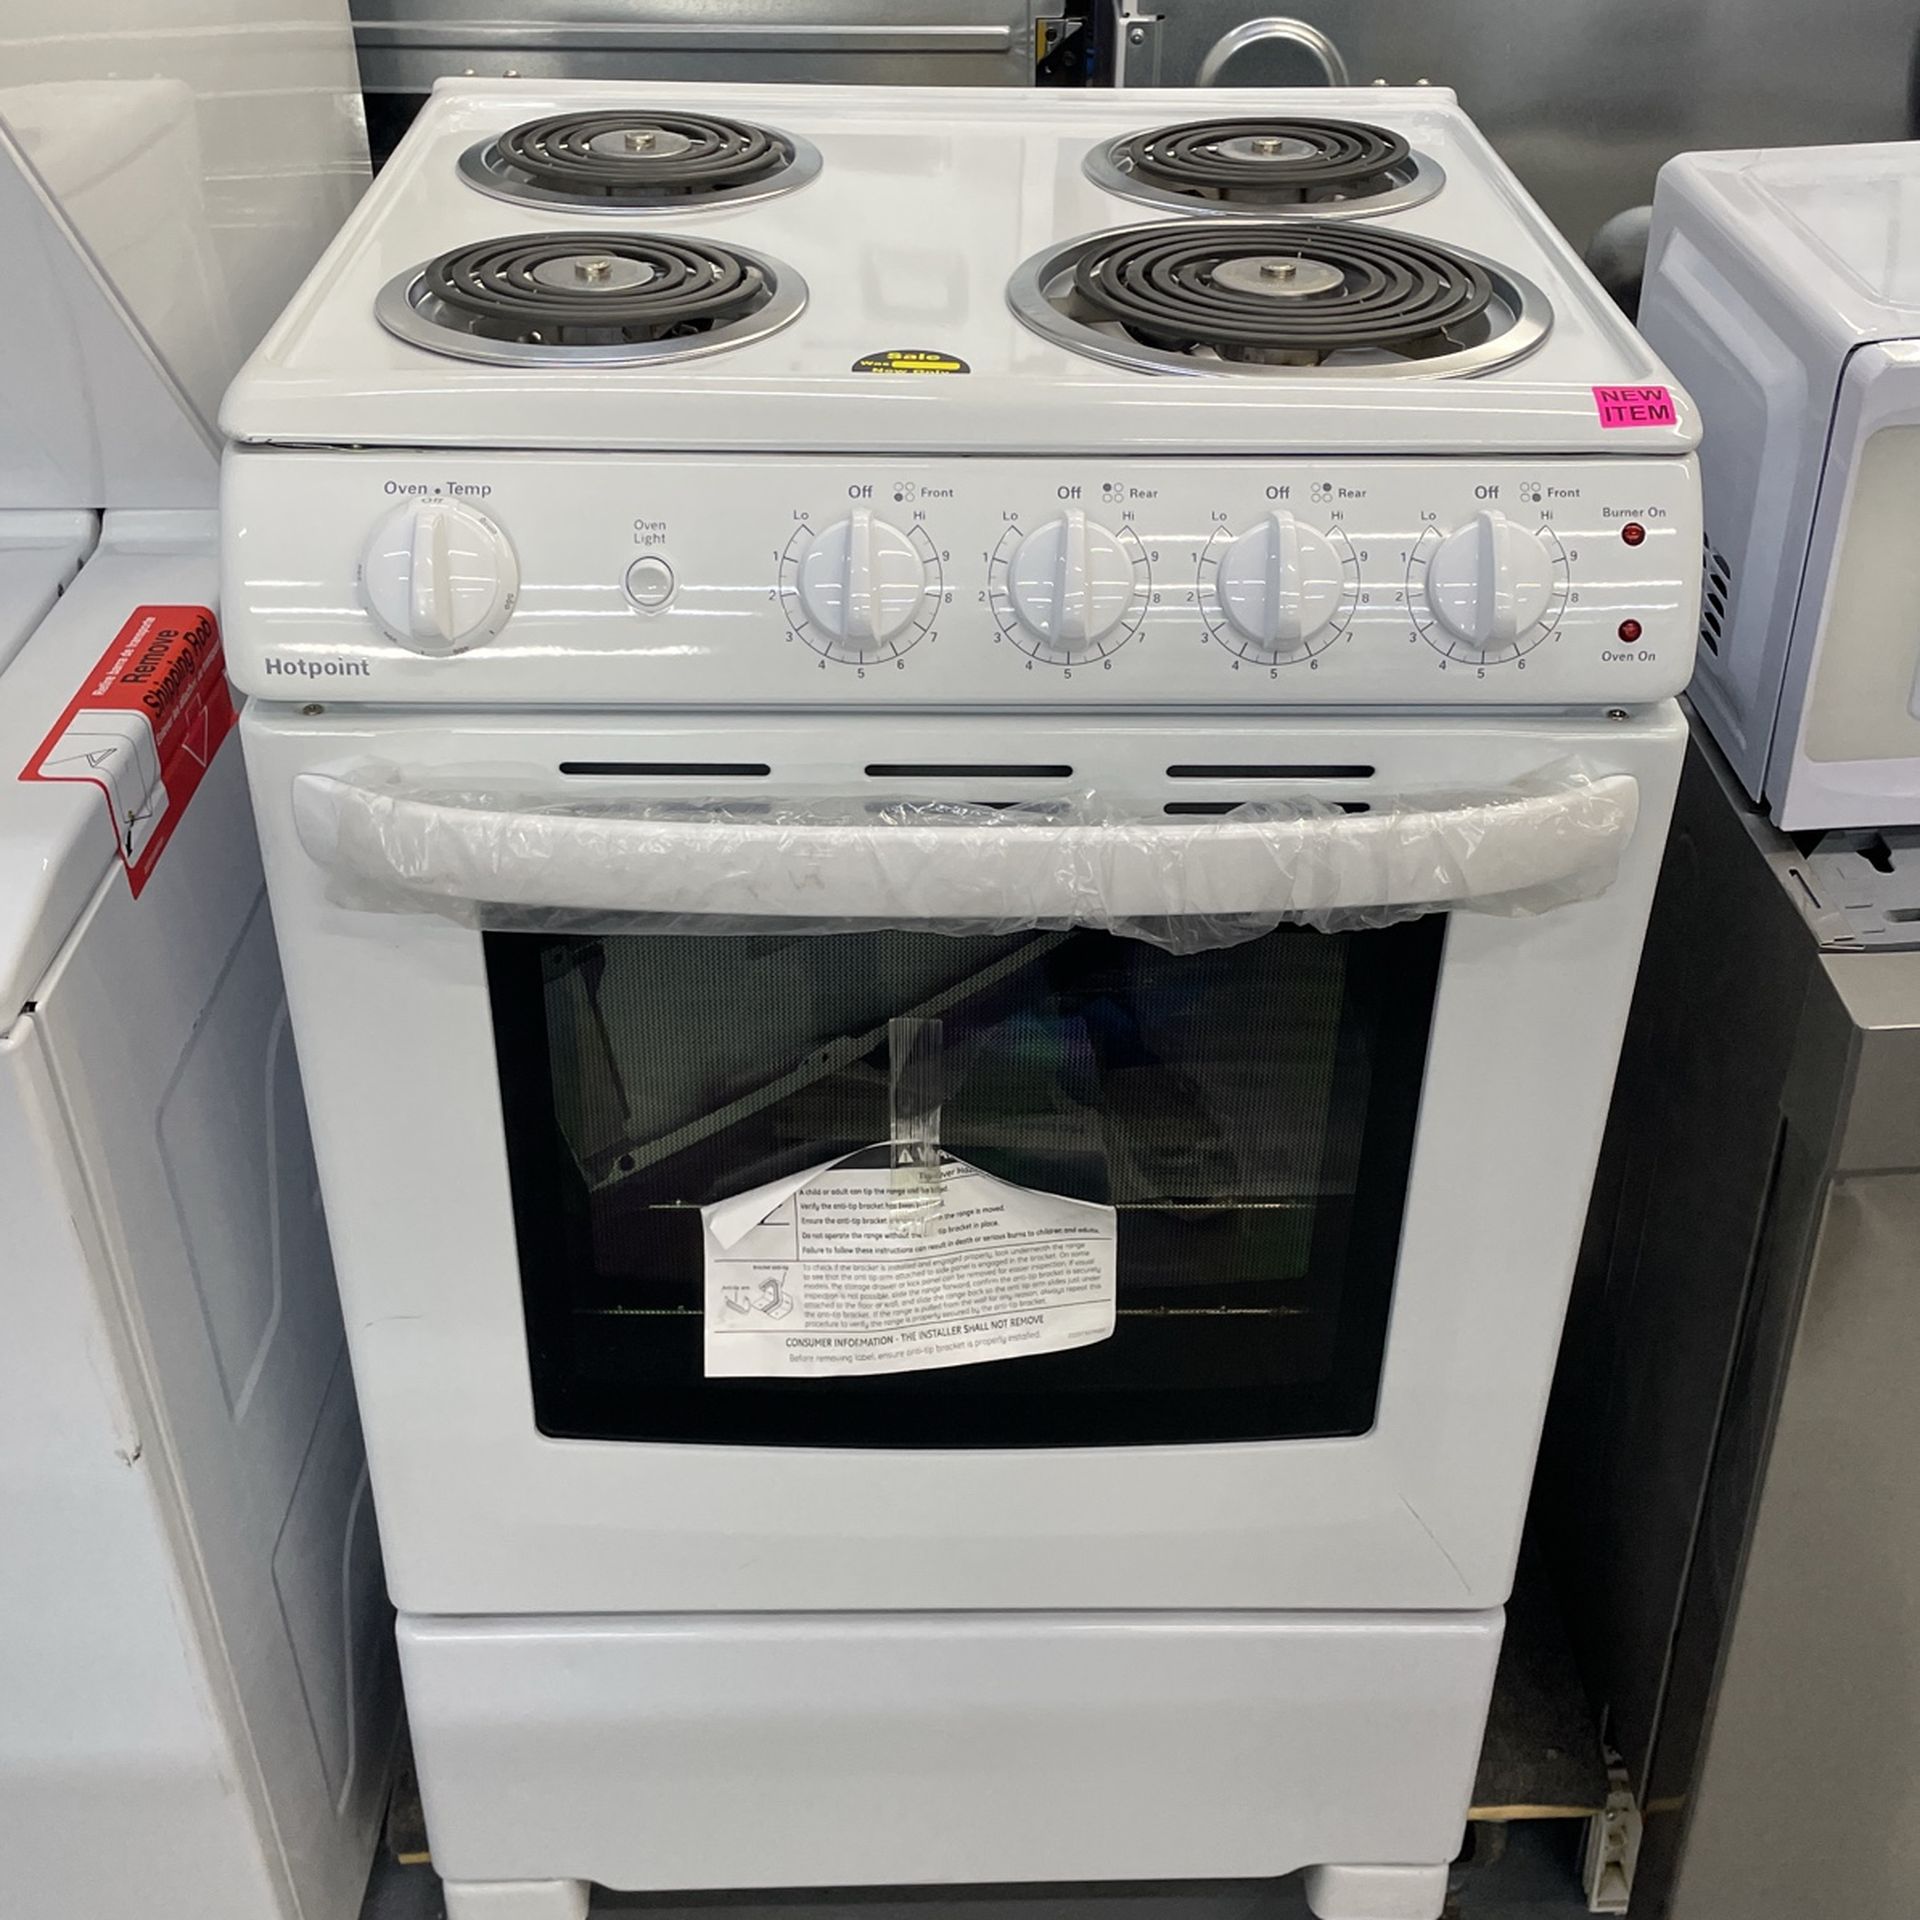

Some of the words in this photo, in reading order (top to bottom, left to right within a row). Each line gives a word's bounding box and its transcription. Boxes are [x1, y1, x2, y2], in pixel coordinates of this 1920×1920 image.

[887, 352, 940, 361] Sale
[1600, 390, 1663, 402] NEW
[1604, 404, 1671, 422] ITEM
[384, 481, 427, 495] Oven
[447, 481, 492, 498] Temp
[848, 485, 873, 498] Off
[921, 488, 954, 498] Front
[1057, 486, 1081, 499] Off
[1130, 489, 1158, 498] Rear
[1266, 486, 1290, 499] Off
[1339, 489, 1366, 498] Rear
[1475, 486, 1499, 499] Off
[1548, 488, 1580, 498] Front
[793, 510, 809, 520] Lo
[913, 510, 926, 520] Hi
[1003, 511, 1018, 521] Lo
[1122, 511, 1134, 521] Hi
[1211, 511, 1227, 521] Lo
[1331, 511, 1344, 521] Hi
[1421, 511, 1436, 521] Lo
[1541, 511, 1553, 520] Hi
[1603, 507, 1644, 517] Burner
[1648, 507, 1666, 517] On
[634, 520, 666, 531] Oven
[634, 533, 666, 545] Light
[773, 551, 778, 561] 1
[942, 552, 949, 561] 9
[983, 552, 988, 562] 1
[1151, 552, 1158, 561] 9
[1192, 553, 1197, 562] 1
[1360, 551, 1368, 561] 9
[1401, 552, 1406, 562] 1
[1570, 551, 1577, 561] 9
[769, 590, 776, 600] 2
[945, 593, 952, 603] 8
[978, 591, 985, 601] 2
[1153, 593, 1161, 603] 8
[1187, 592, 1194, 601] 2
[1362, 593, 1369, 603] 8
[1396, 592, 1403, 601] 2
[1571, 593, 1579, 603] 8
[786, 632, 793, 641] 3
[931, 632, 938, 642] 7
[994, 633, 1001, 643] 3
[1139, 633, 1145, 642] 7
[1202, 633, 1208, 643] 3
[1346, 632, 1353, 642] 7
[1409, 633, 1417, 643] 3
[1555, 632, 1562, 642] 7
[121, 629, 179, 683] Remove
[1602, 651, 1633, 662] Oven
[1638, 651, 1656, 662] On
[142, 648, 196, 718] Shipping
[183, 615, 212, 656] Rod
[266, 659, 370, 678] Hotpoint
[818, 660, 826, 670] 4
[897, 659, 904, 669] 6
[1025, 660, 1032, 670] 4
[1104, 660, 1111, 670] 6
[1232, 661, 1239, 670] 4
[1311, 660, 1318, 670] 6
[1439, 660, 1446, 670] 4
[1518, 659, 1525, 669] 6
[857, 668, 864, 678] 5
[1064, 669, 1071, 679] 5
[1270, 669, 1277, 679] 5
[1478, 669, 1485, 679] 5
[863, 1187, 873, 1197] tip
[874, 1187, 885, 1195] the
[800, 1202, 820, 1211] Verify
[859, 1202, 885, 1210] bracket
[802, 1217, 823, 1225] Ensure
[825, 1217, 836, 1225] the
[948, 1223, 972, 1232] bracket
[825, 1232, 850, 1240] operate
[864, 1232, 883, 1240] range
[875, 1246, 913, 1254] instructions
[928, 1242, 946, 1250] result
[955, 1237, 973, 1246] death
[983, 1233, 1006, 1242] serious
[1007, 1231, 1027, 1240] burns
[786, 1337, 832, 1348] CONSUMER
[834, 1335, 894, 1348] INFORMATION
[901, 1332, 916, 1342] THE
[919, 1325, 962, 1339] INSTALLER
[963, 1322, 989, 1334] SHALL
[991, 1319, 1008, 1329] NOT
[1010, 1314, 1044, 1328] REMOVE
[789, 1353, 815, 1362] Before
[816, 1354, 853, 1364] removing
[877, 1349, 904, 1360] ensure
[974, 1335, 1007, 1348] properly
